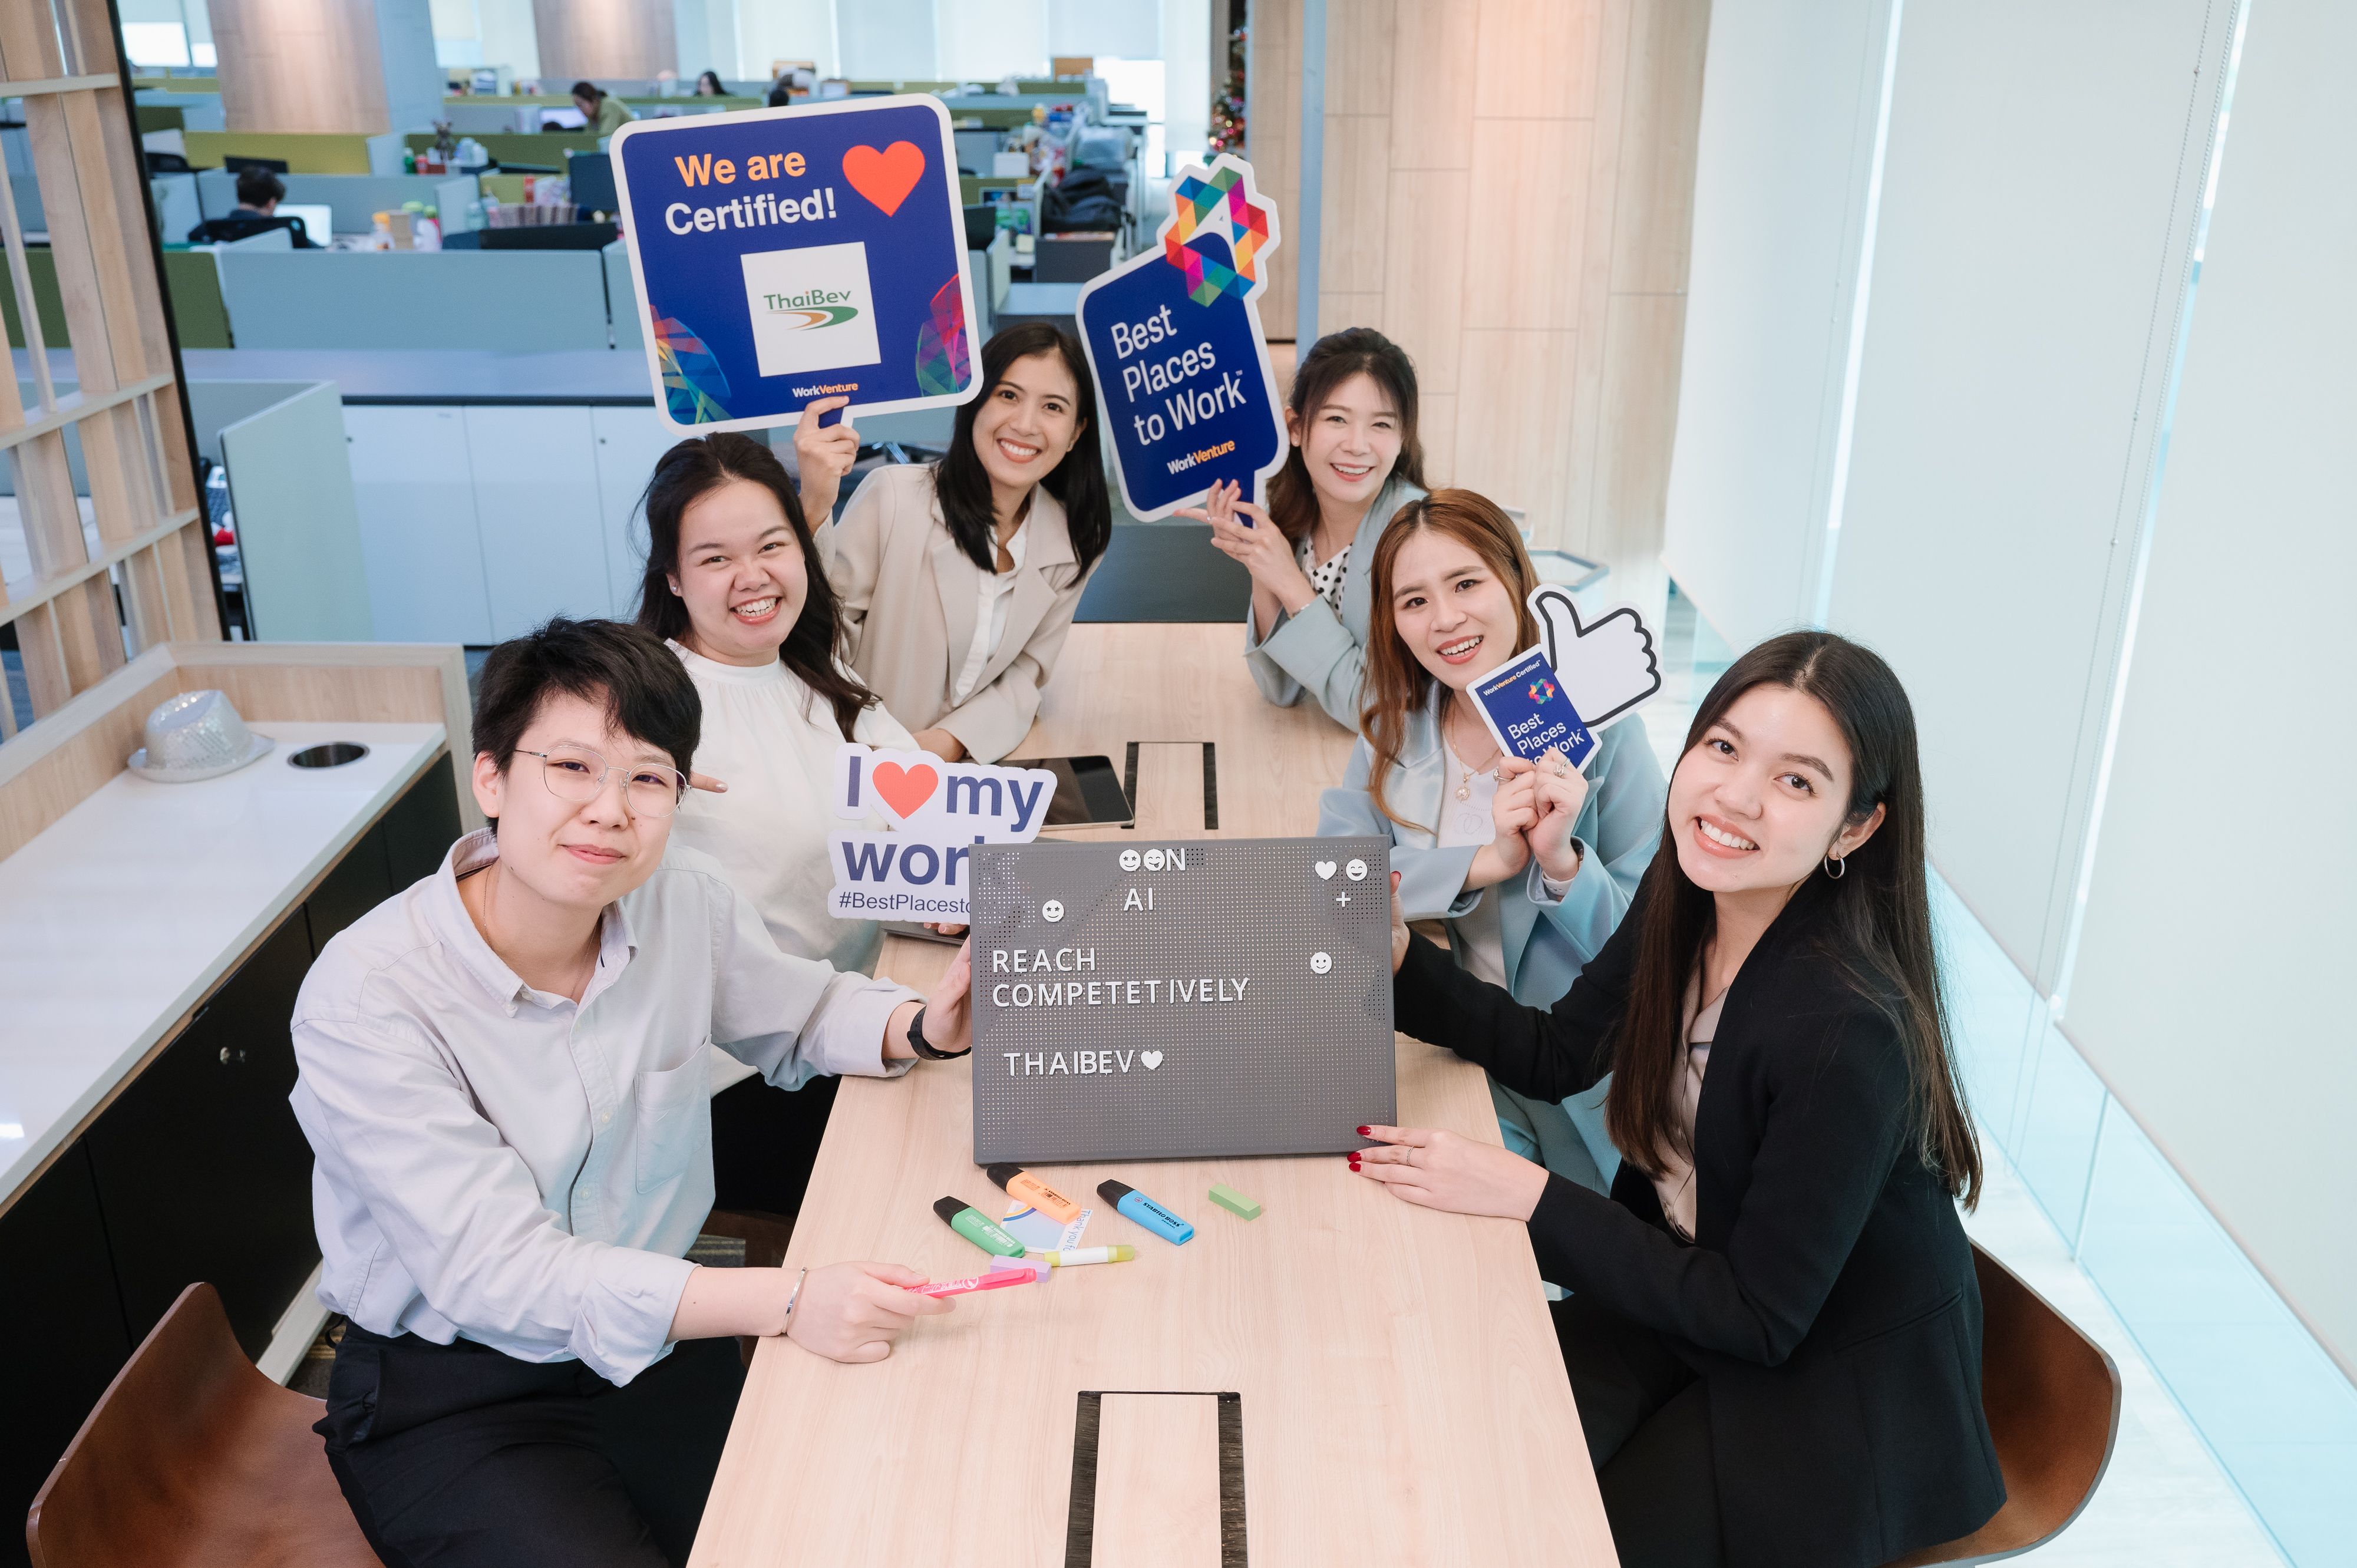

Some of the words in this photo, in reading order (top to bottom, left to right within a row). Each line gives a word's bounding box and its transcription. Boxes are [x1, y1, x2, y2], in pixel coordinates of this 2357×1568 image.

[675, 154, 735, 187] We
[747, 152, 806, 181] are
[665, 188, 837, 235] Certified!
[763, 289, 851, 310] ThaiBev
[1111, 305, 1177, 359] Best
[1122, 342, 1216, 403] Places
[792, 382, 858, 398] WorkVenture
[1134, 413, 1165, 446] to
[1167, 440, 1235, 475] WorkVenture
[1483, 675, 1517, 696] WorkVenture
[1507, 713, 1544, 740] Best
[1517, 722, 1566, 755] Places
[847, 756, 861, 807] I
[946, 775, 1044, 832] my
[841, 835, 985, 886] wor
[1123, 887, 1153, 912] AI
[993, 948, 1096, 973] REACH
[1003, 1049, 1135, 1077] THAIBEV
[1074, 1210, 1091, 1230] Thank
[1143, 1202, 1166, 1218] STABILO
[1165, 1216, 1181, 1227] BOSS
[1067, 1230, 1079, 1244] you
